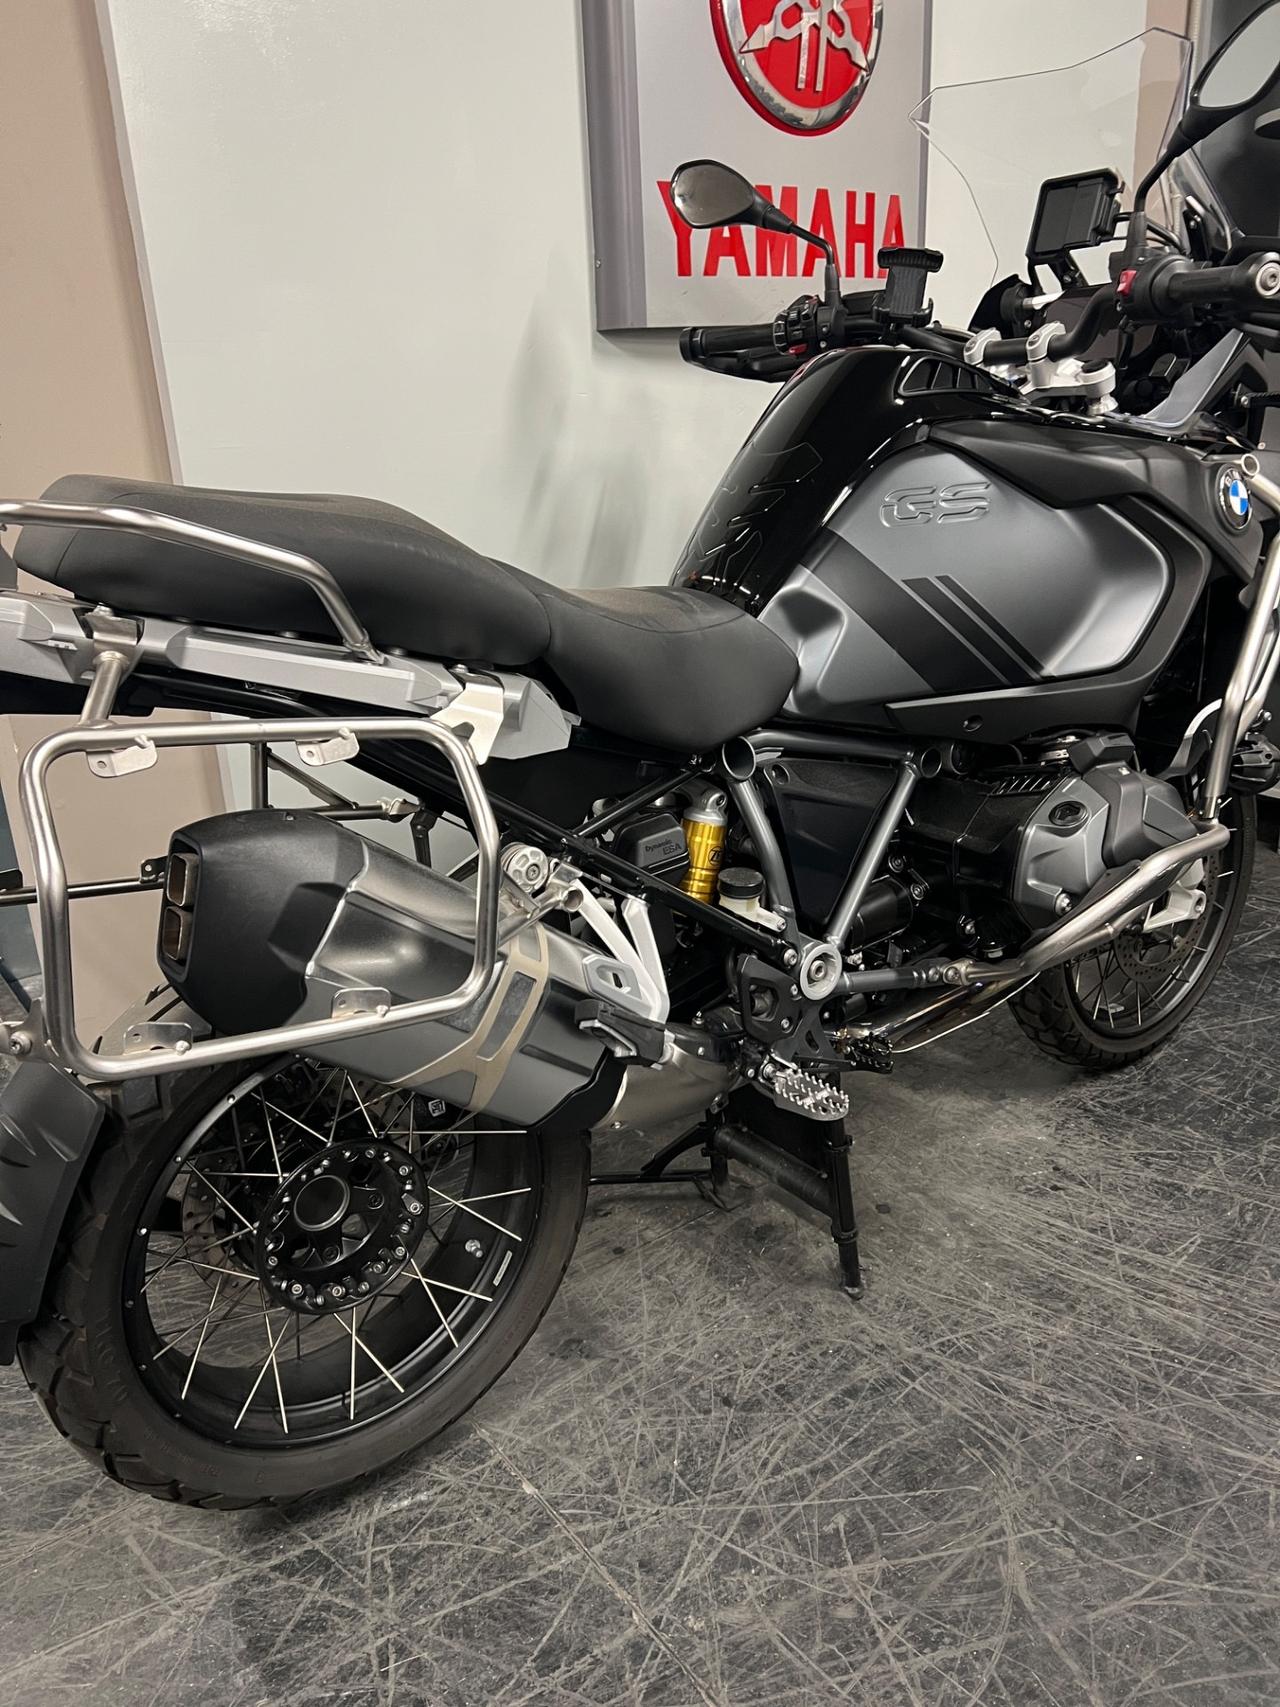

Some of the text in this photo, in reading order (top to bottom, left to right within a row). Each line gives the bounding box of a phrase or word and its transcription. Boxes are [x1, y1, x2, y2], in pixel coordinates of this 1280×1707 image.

[656, 180, 905, 279] YAMAHA
[880, 481, 991, 528] GS
[662, 842, 682, 855] ESA
